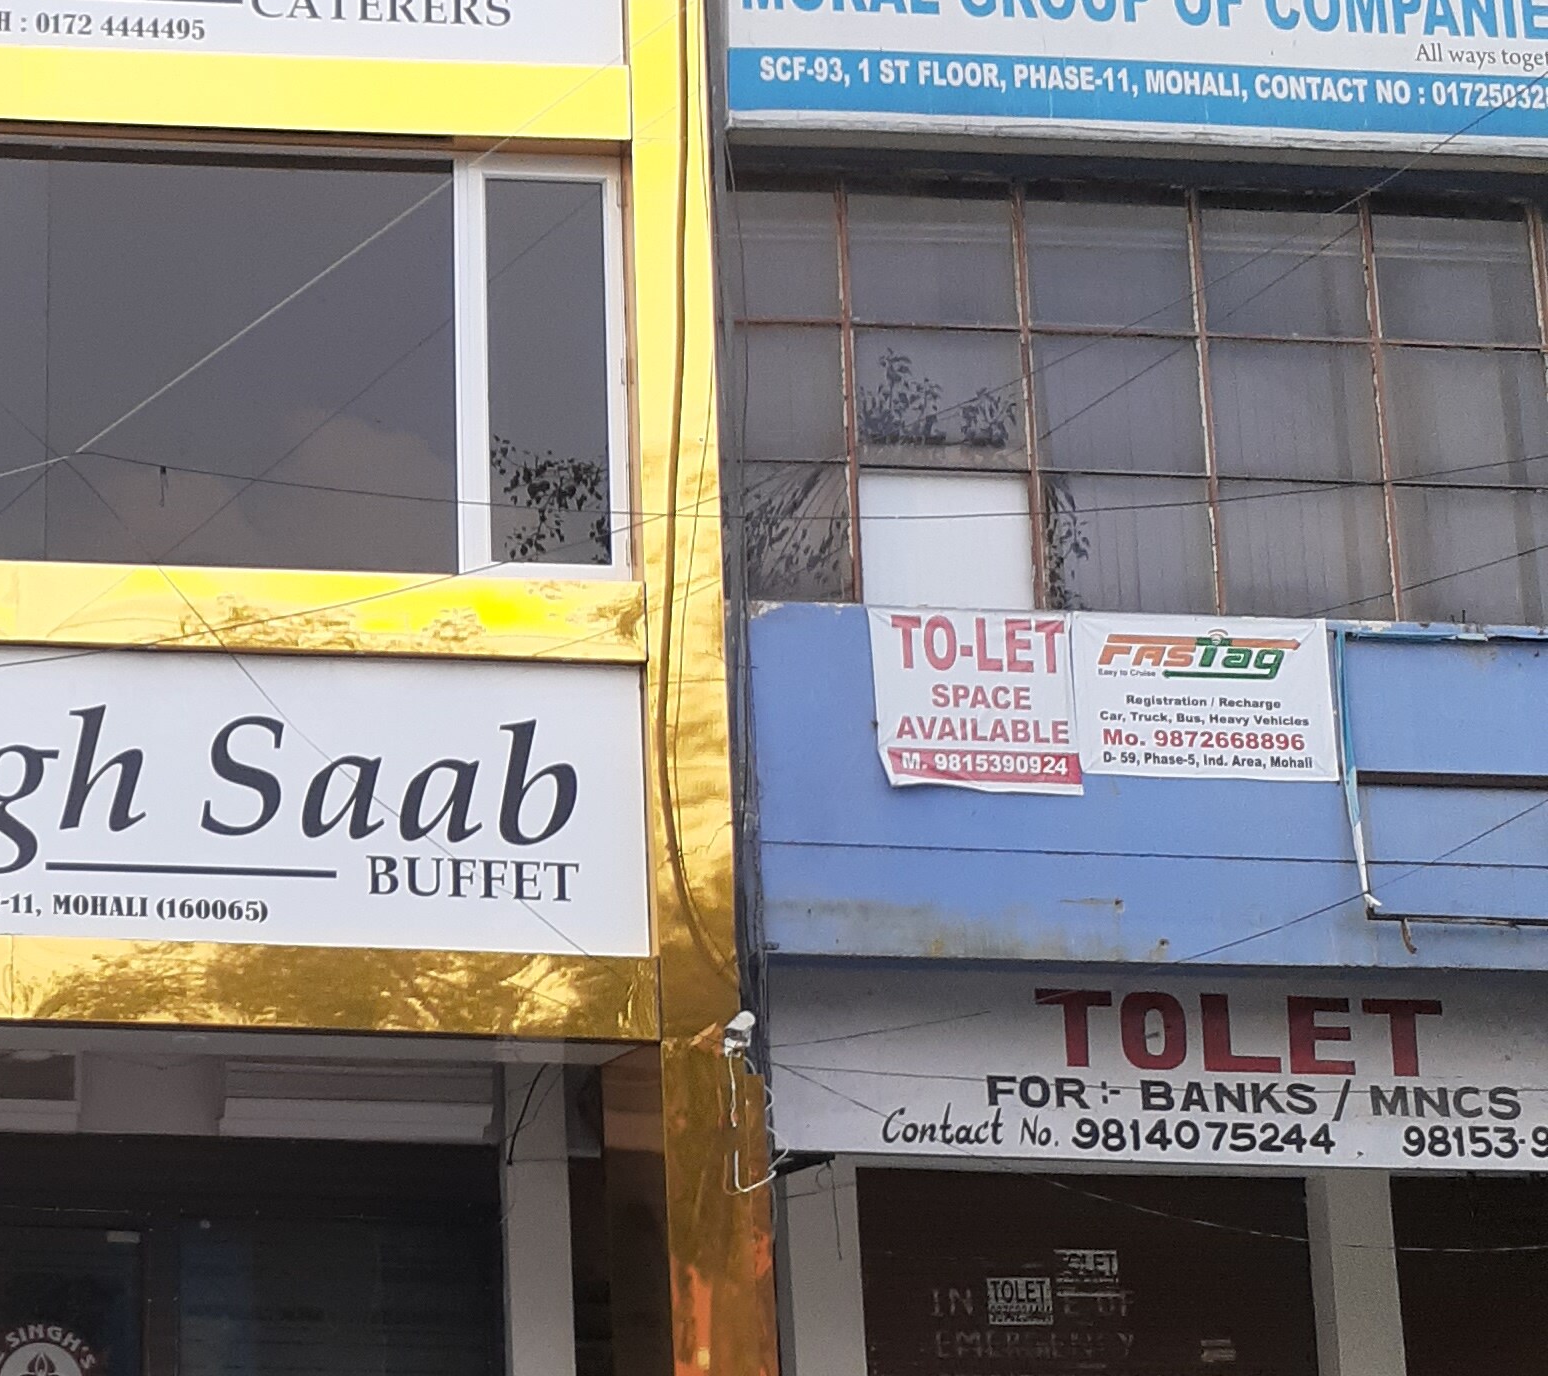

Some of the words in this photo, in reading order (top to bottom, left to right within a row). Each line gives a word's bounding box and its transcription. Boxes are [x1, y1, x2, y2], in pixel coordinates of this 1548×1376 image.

[36, 12, 93, 37] 0172
[100, 15, 207, 41] 4444495
[1415, 42, 1443, 62] All
[1448, 49, 1496, 71] ways
[759, 56, 850, 88] SCF-93,
[858, 57, 870, 83] 1
[879, 59, 910, 85] ST
[918, 61, 1006, 94] FLOOR,
[1014, 64, 1138, 98] PHASE-11,
[1144, 69, 1248, 103] MOHALI,
[1254, 74, 1368, 103] CONTACT
[1432, 81, 1548, 110] 01725032
[891, 614, 1065, 674] TO-LET
[931, 684, 1031, 711] SPACE
[1126, 694, 1207, 708] Registration
[1219, 698, 1281, 711] Recharge
[897, 715, 1069, 745] AVAILABLE
[1100, 711, 1126, 723] Car,
[1130, 712, 1173, 724] Truck,
[1176, 713, 1205, 725] Bus,
[1209, 714, 1250, 727] Heavy
[1254, 715, 1310, 727] Vehicles
[1103, 728, 1146, 747] Mo.
[1154, 729, 1305, 750] 9872668896
[902, 752, 927, 771] M.
[935, 753, 1068, 776] 9815390924
[1144, 753, 1200, 768] Phase-5,
[1204, 754, 1228, 767] Ind.
[1231, 755, 1267, 769] Area,
[1270, 756, 1313, 769] Mohali
[200, 715, 579, 846] Saab
[366, 855, 579, 902] BUFFET
[53, 894, 150, 921] MOHALI
[156, 896, 269, 923] (160065)
[1035, 987, 1443, 1078] TOLET
[1141, 1079, 1318, 1114] BANKS
[1370, 1085, 1522, 1121] MNCS
[882, 1102, 1004, 1147] Contact
[1019, 1116, 1060, 1148] No.
[1071, 1118, 1337, 1155] 9814075244
[990, 1280, 1046, 1309] TOLET
